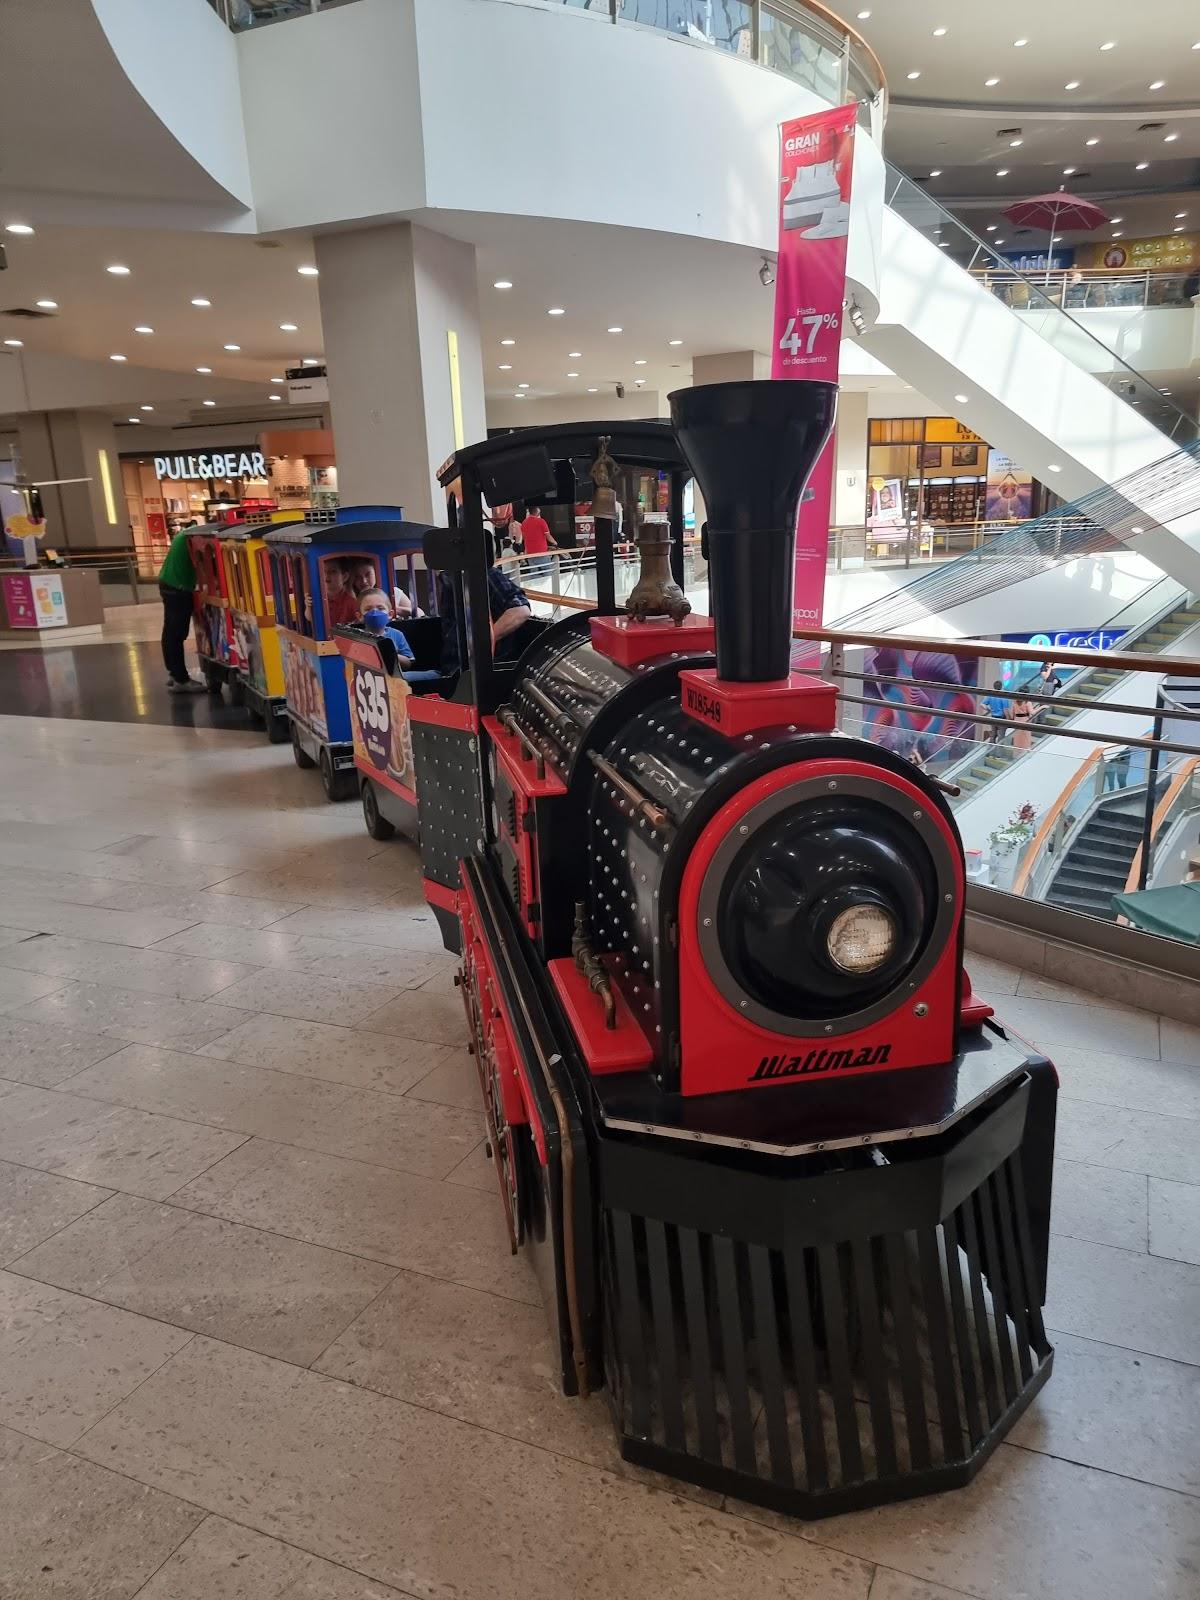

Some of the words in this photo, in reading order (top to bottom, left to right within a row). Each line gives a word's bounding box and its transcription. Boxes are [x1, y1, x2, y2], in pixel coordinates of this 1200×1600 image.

[785, 132, 820, 151] GRAN
[780, 312, 839, 356] 47%
[154, 452, 267, 480] PULL&BEAR
[580, 520, 591, 532] 50
[356, 669, 389, 732] $35
[747, 1043, 892, 1082] Wattman
